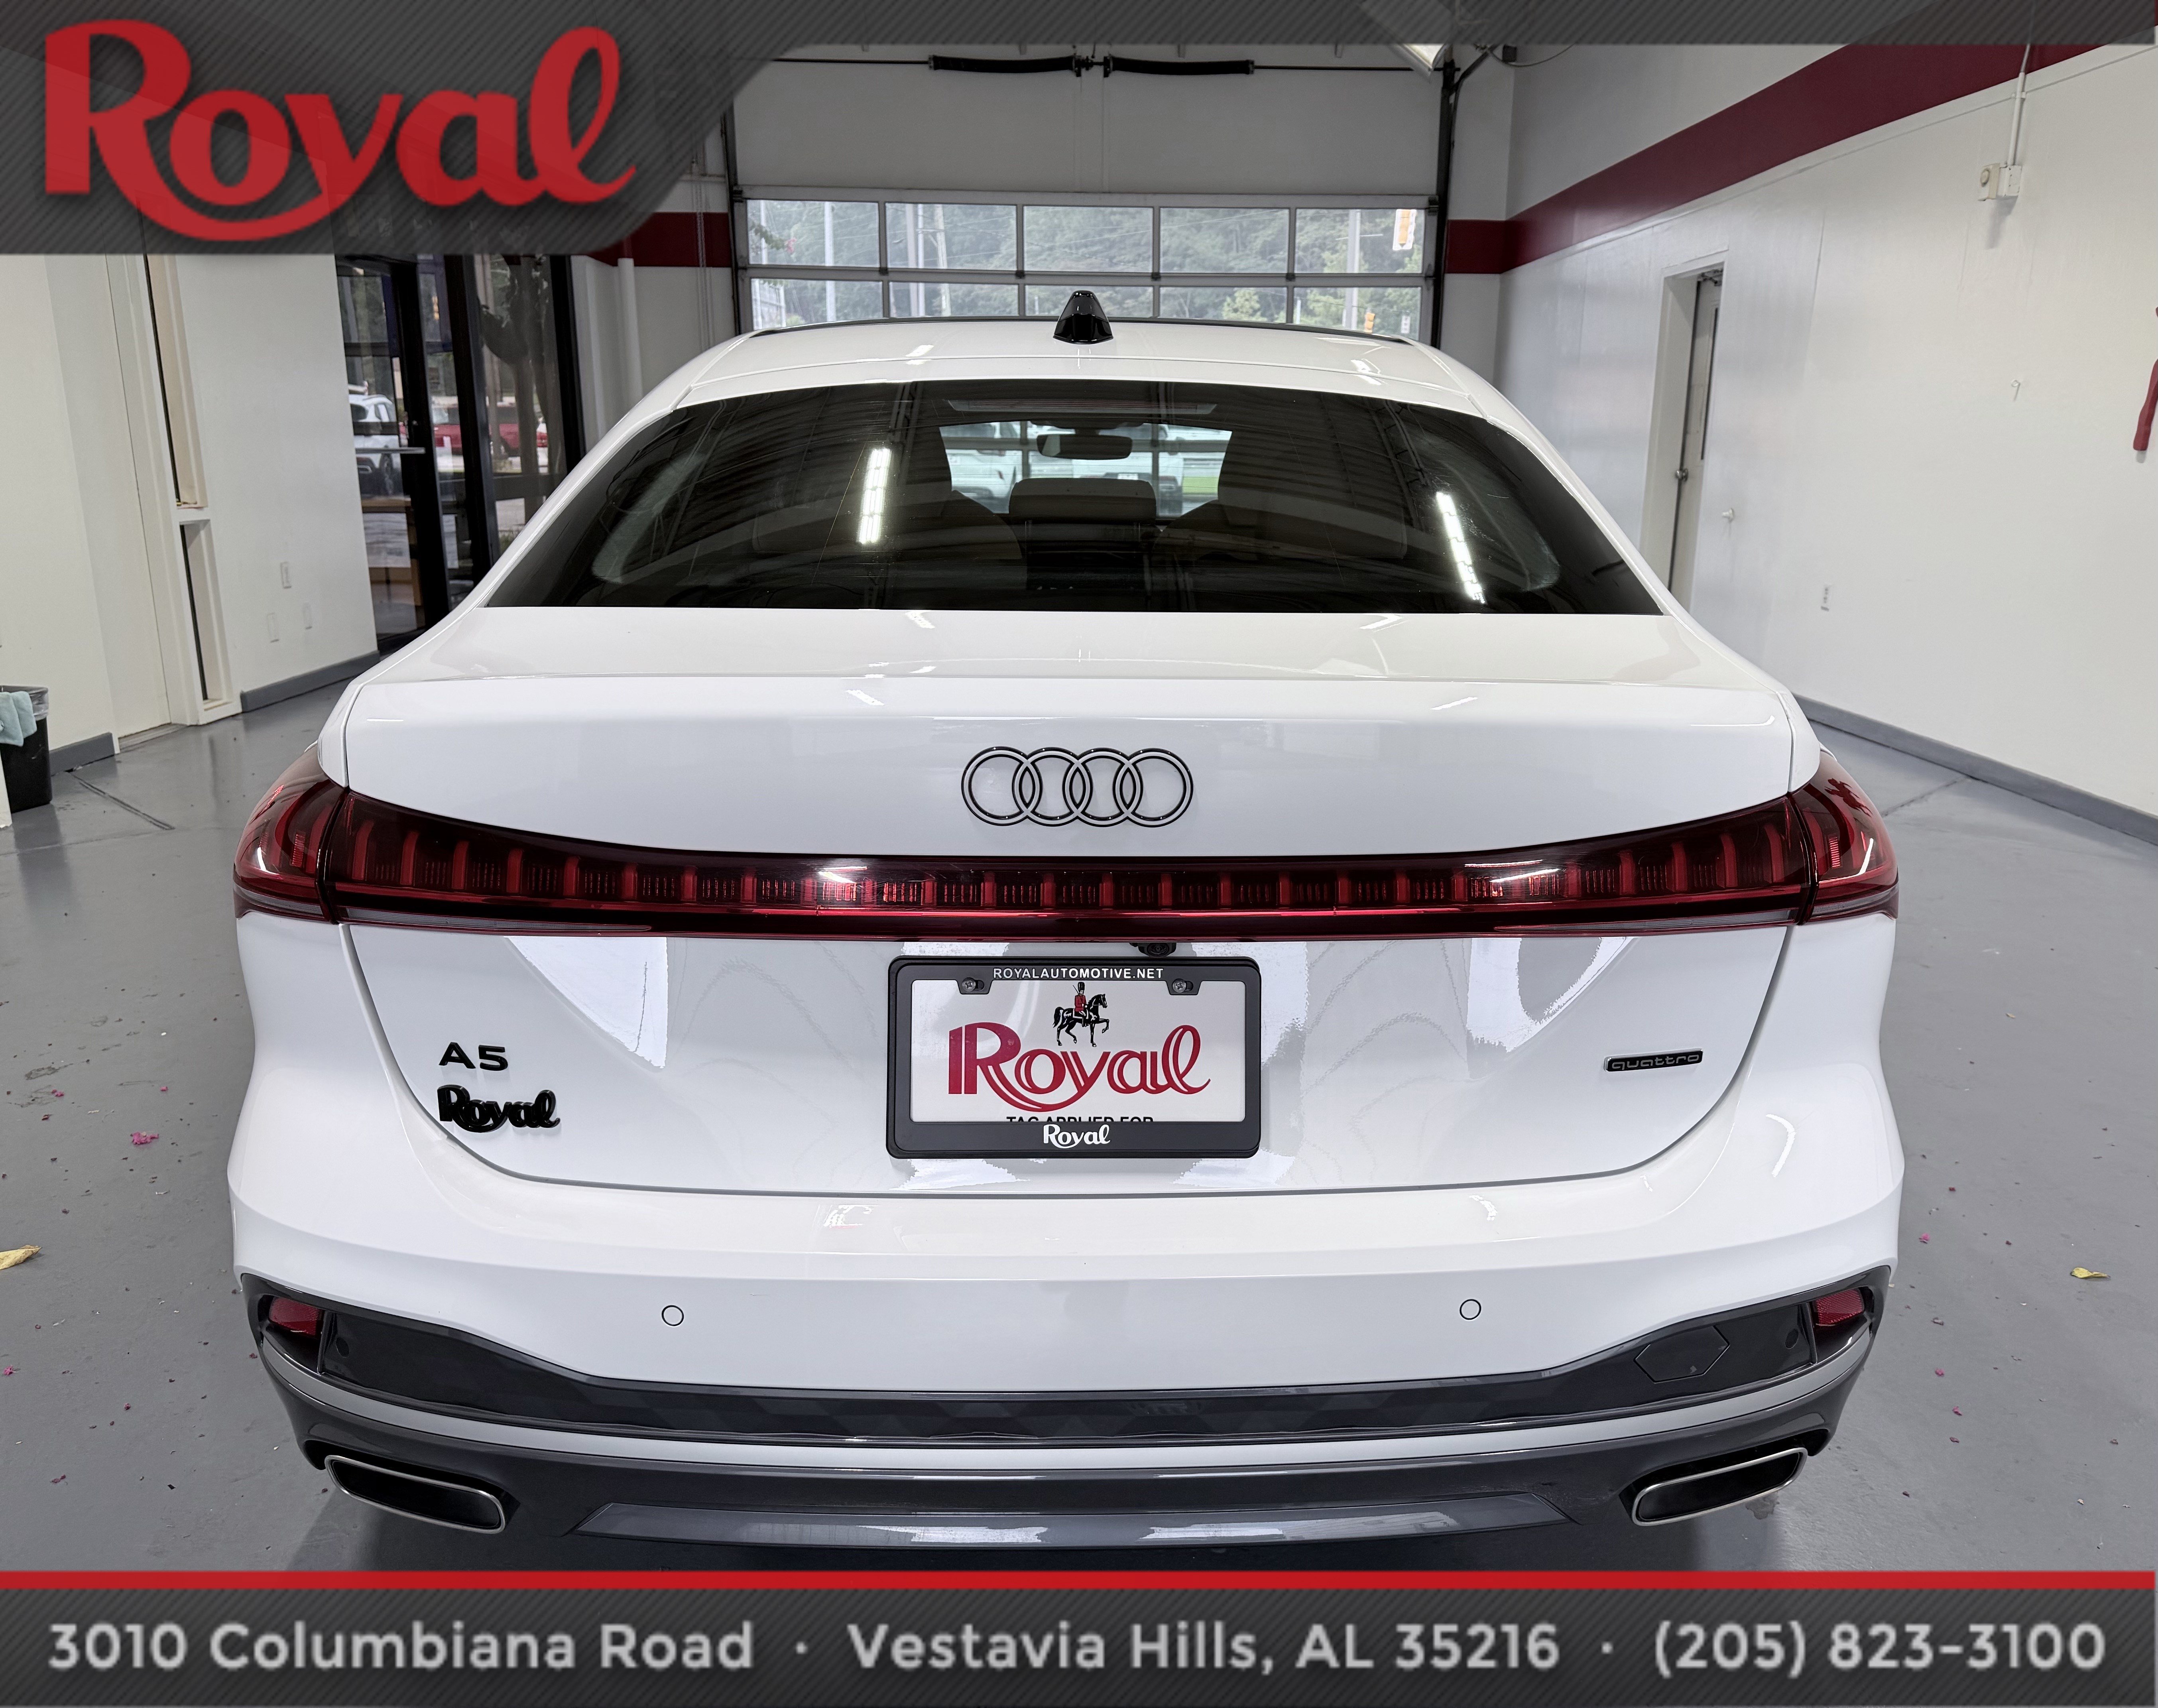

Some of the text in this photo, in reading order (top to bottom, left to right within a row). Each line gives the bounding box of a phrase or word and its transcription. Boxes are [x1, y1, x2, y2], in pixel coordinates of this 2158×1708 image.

[993, 968, 1163, 979] ROYALAUTOMOTIVE.NET
[439, 1042, 508, 1071] A5
[948, 1022, 1211, 1112] Royal
[1612, 1055, 1700, 1070] quattro
[437, 1084, 561, 1133] Royal
[1043, 1124, 1111, 1149] Royal
